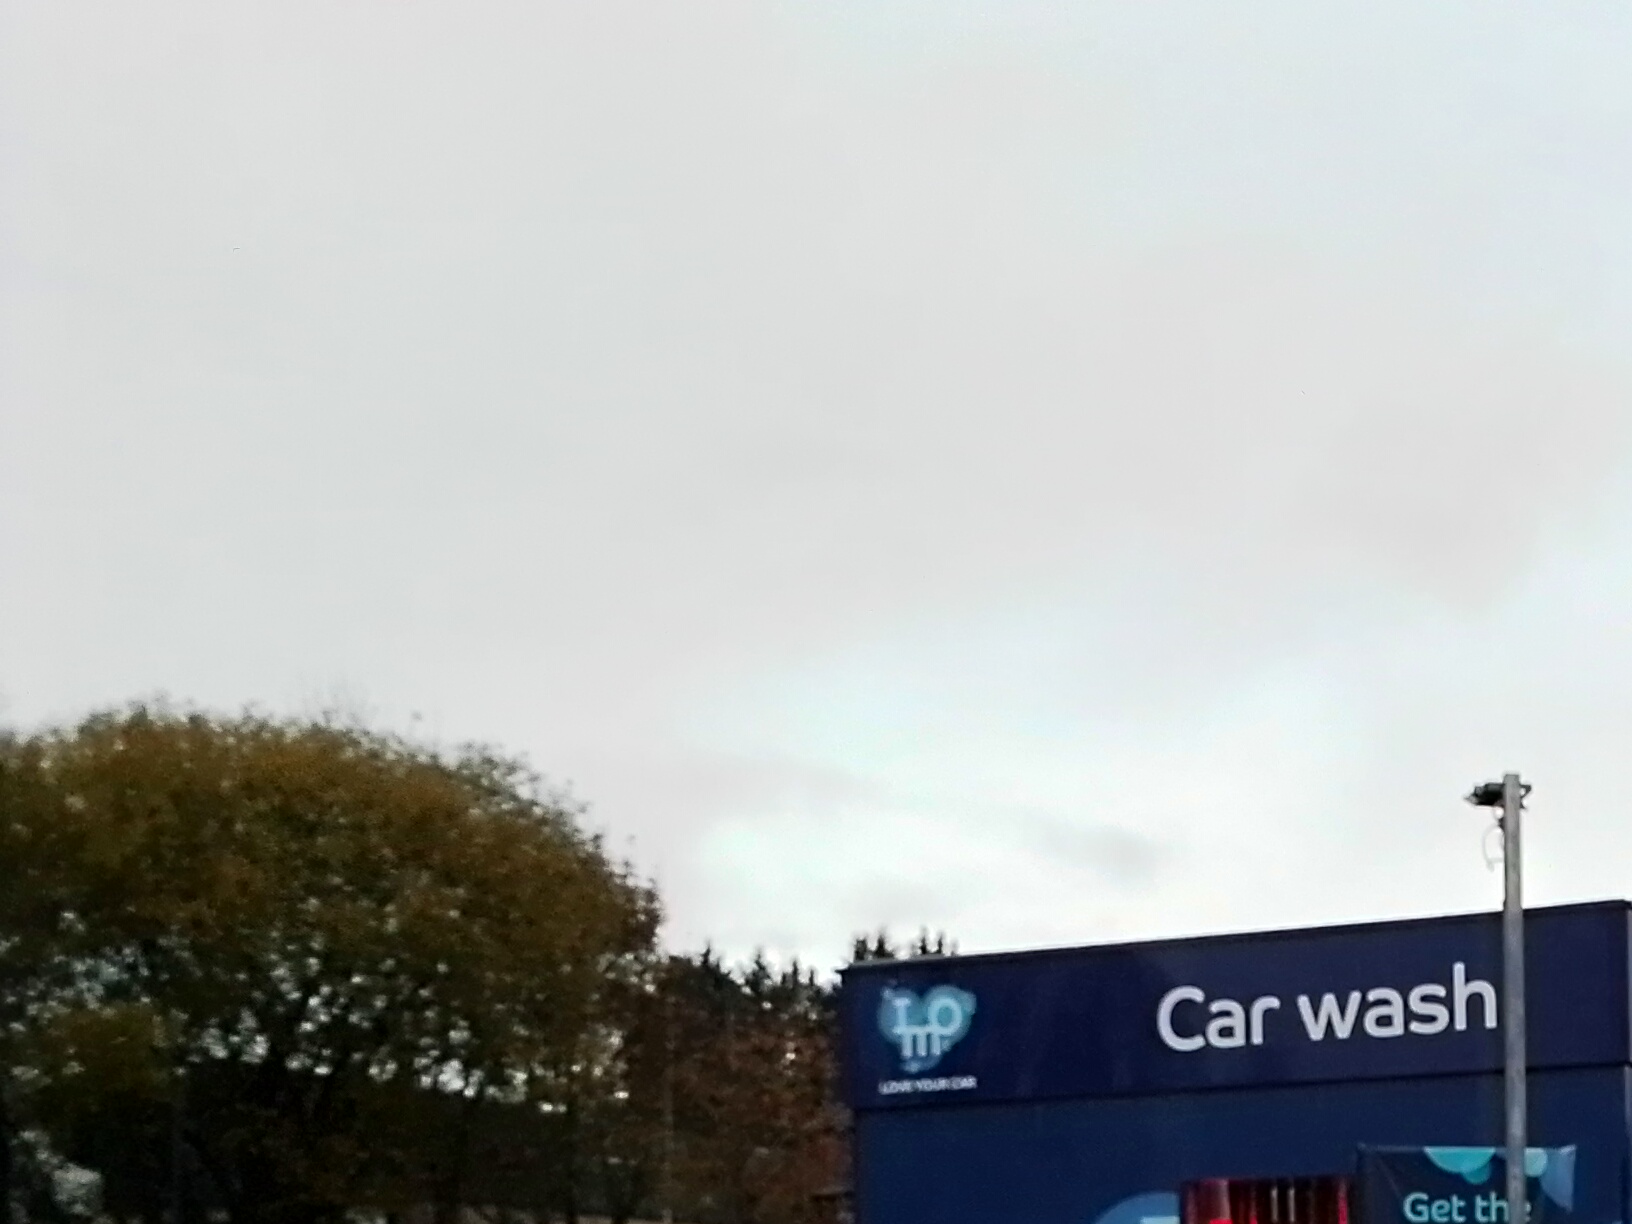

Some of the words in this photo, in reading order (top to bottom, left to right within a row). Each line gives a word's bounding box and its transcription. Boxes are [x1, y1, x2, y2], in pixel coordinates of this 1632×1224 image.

[1156, 984, 1281, 1051] Car
[1296, 961, 1498, 1041] wash
[1402, 1191, 1467, 1224] Get
[1474, 1191, 1532, 1224] th
